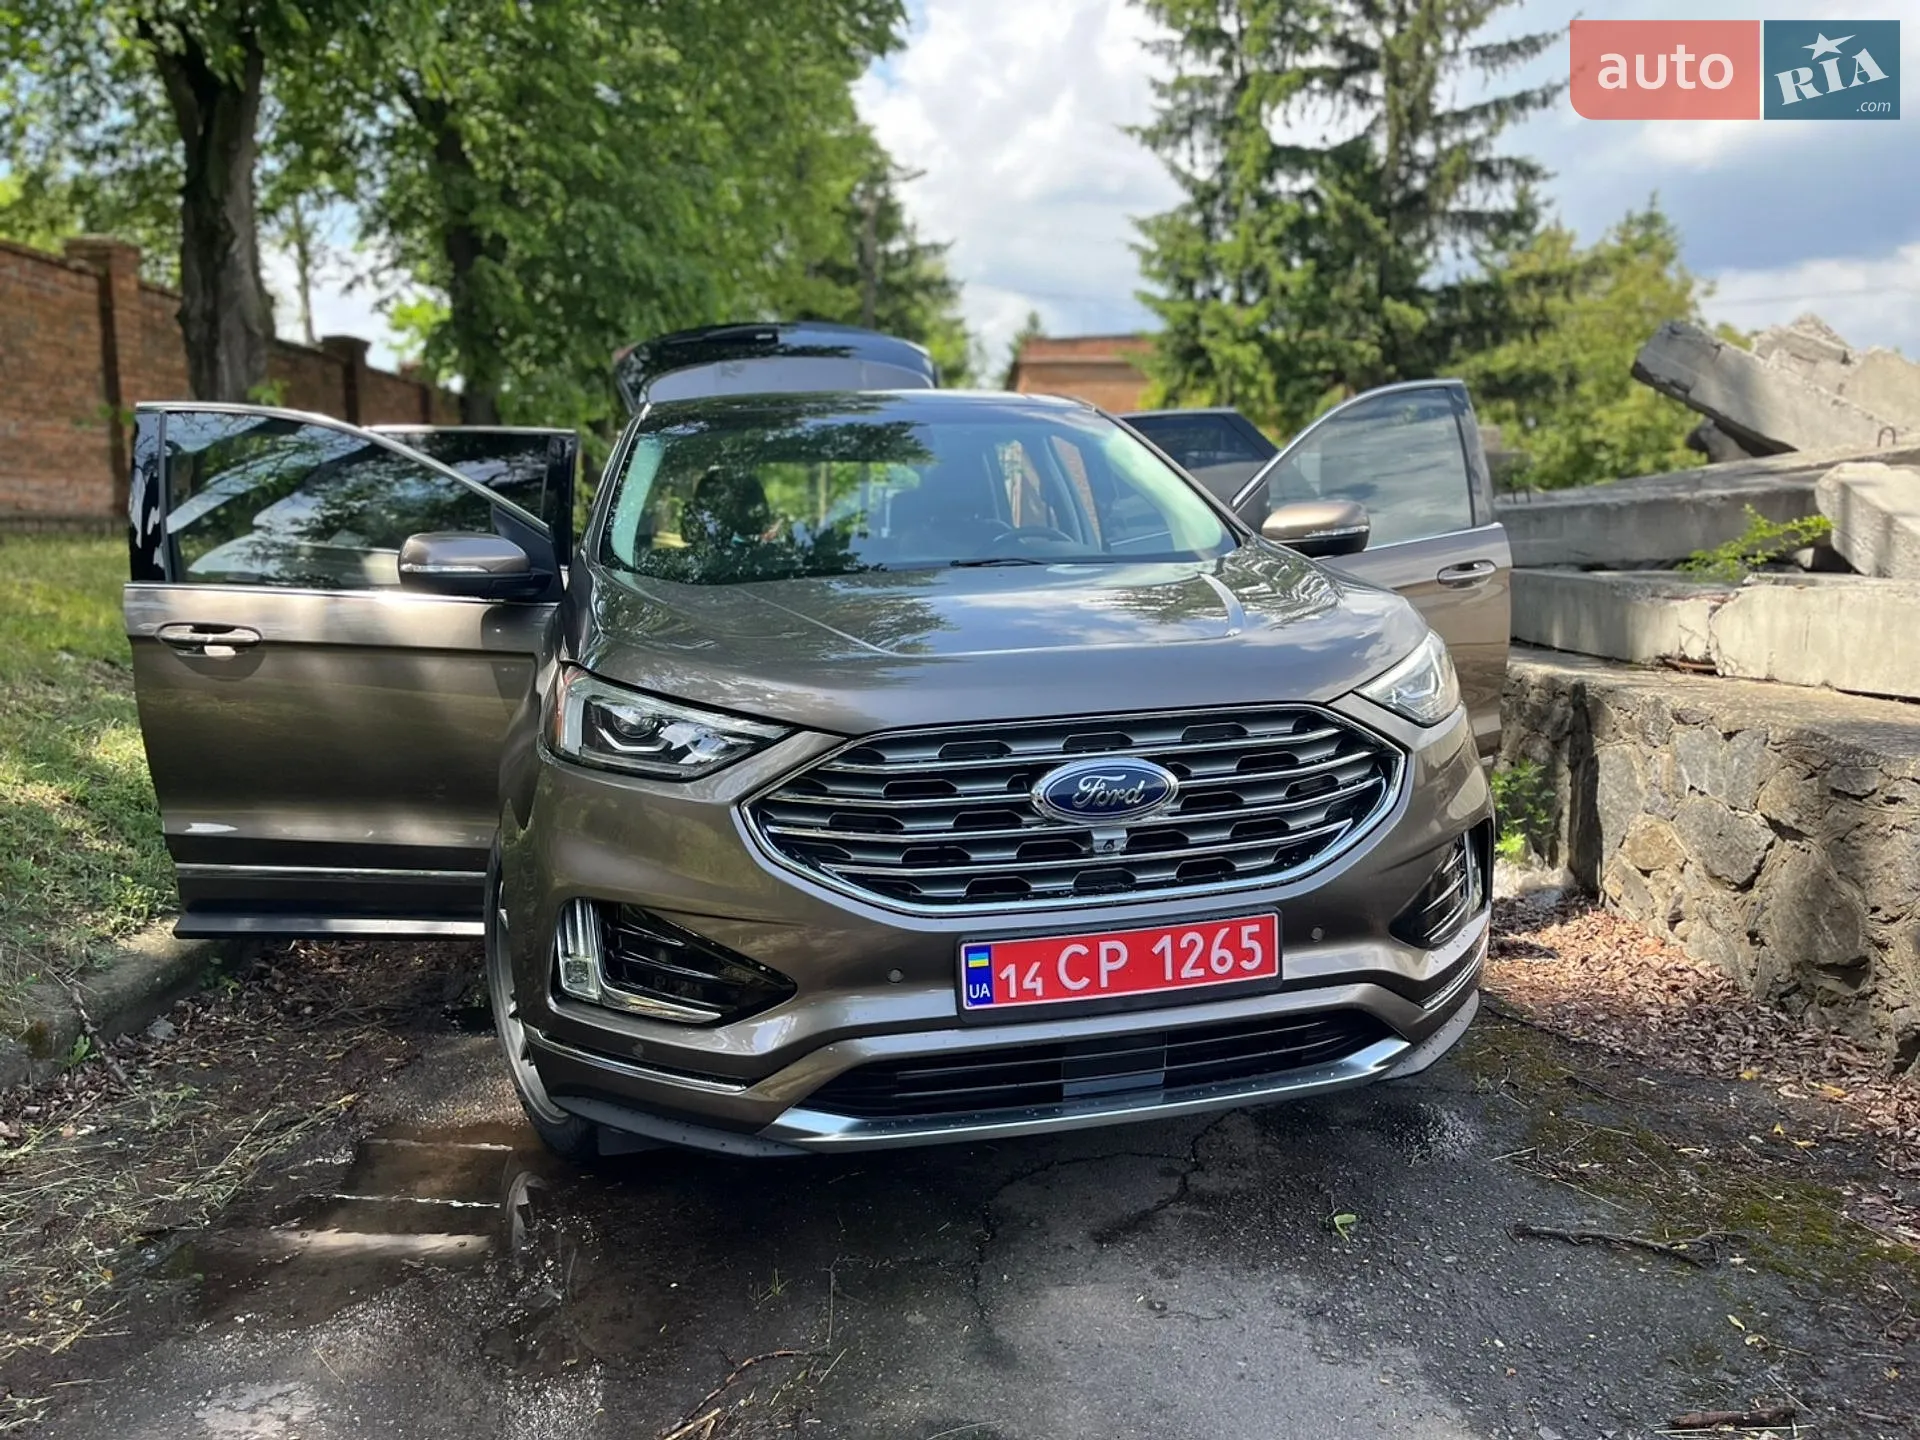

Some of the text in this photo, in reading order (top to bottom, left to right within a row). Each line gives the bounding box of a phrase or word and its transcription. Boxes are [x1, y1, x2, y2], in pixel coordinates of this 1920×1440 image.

[1071, 773, 1146, 809] Ford
[999, 924, 1263, 999] 14 CP 1265
[968, 983, 991, 999] UA
